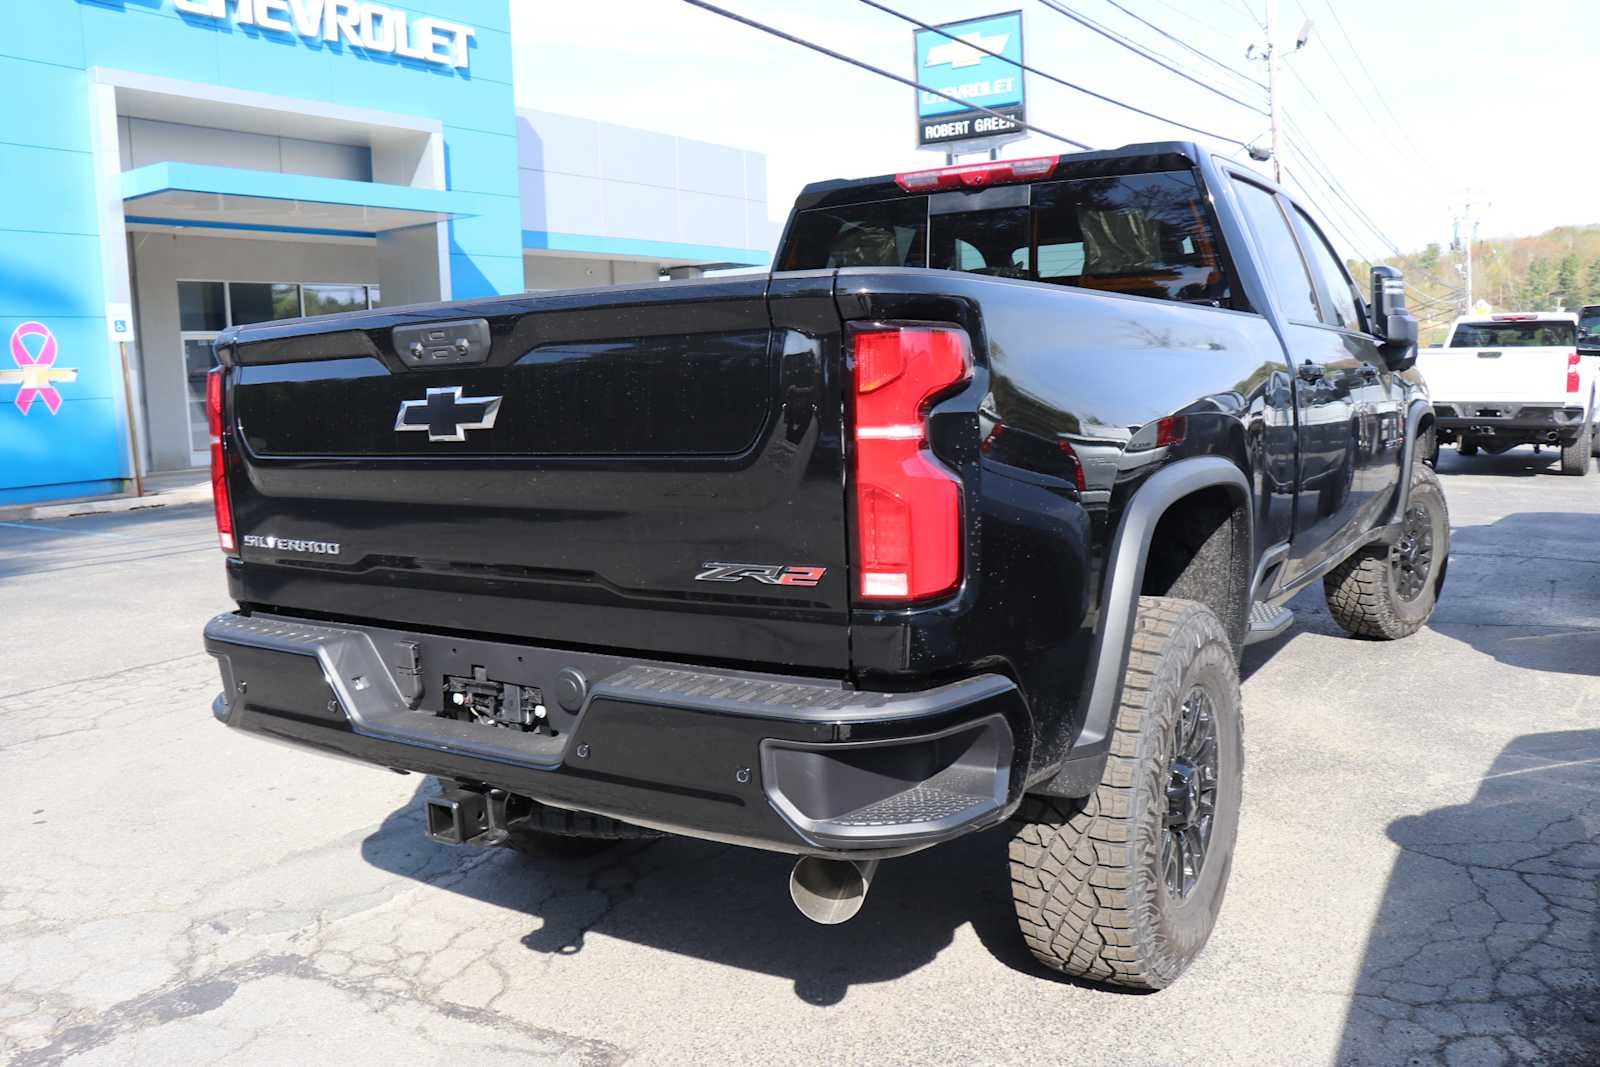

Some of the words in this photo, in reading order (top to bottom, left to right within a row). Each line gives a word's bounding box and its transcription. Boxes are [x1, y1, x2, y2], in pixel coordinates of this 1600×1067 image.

[925, 121, 970, 139] ROBERT
[243, 535, 340, 555] SILVERADO
[695, 562, 827, 586] ZR2
